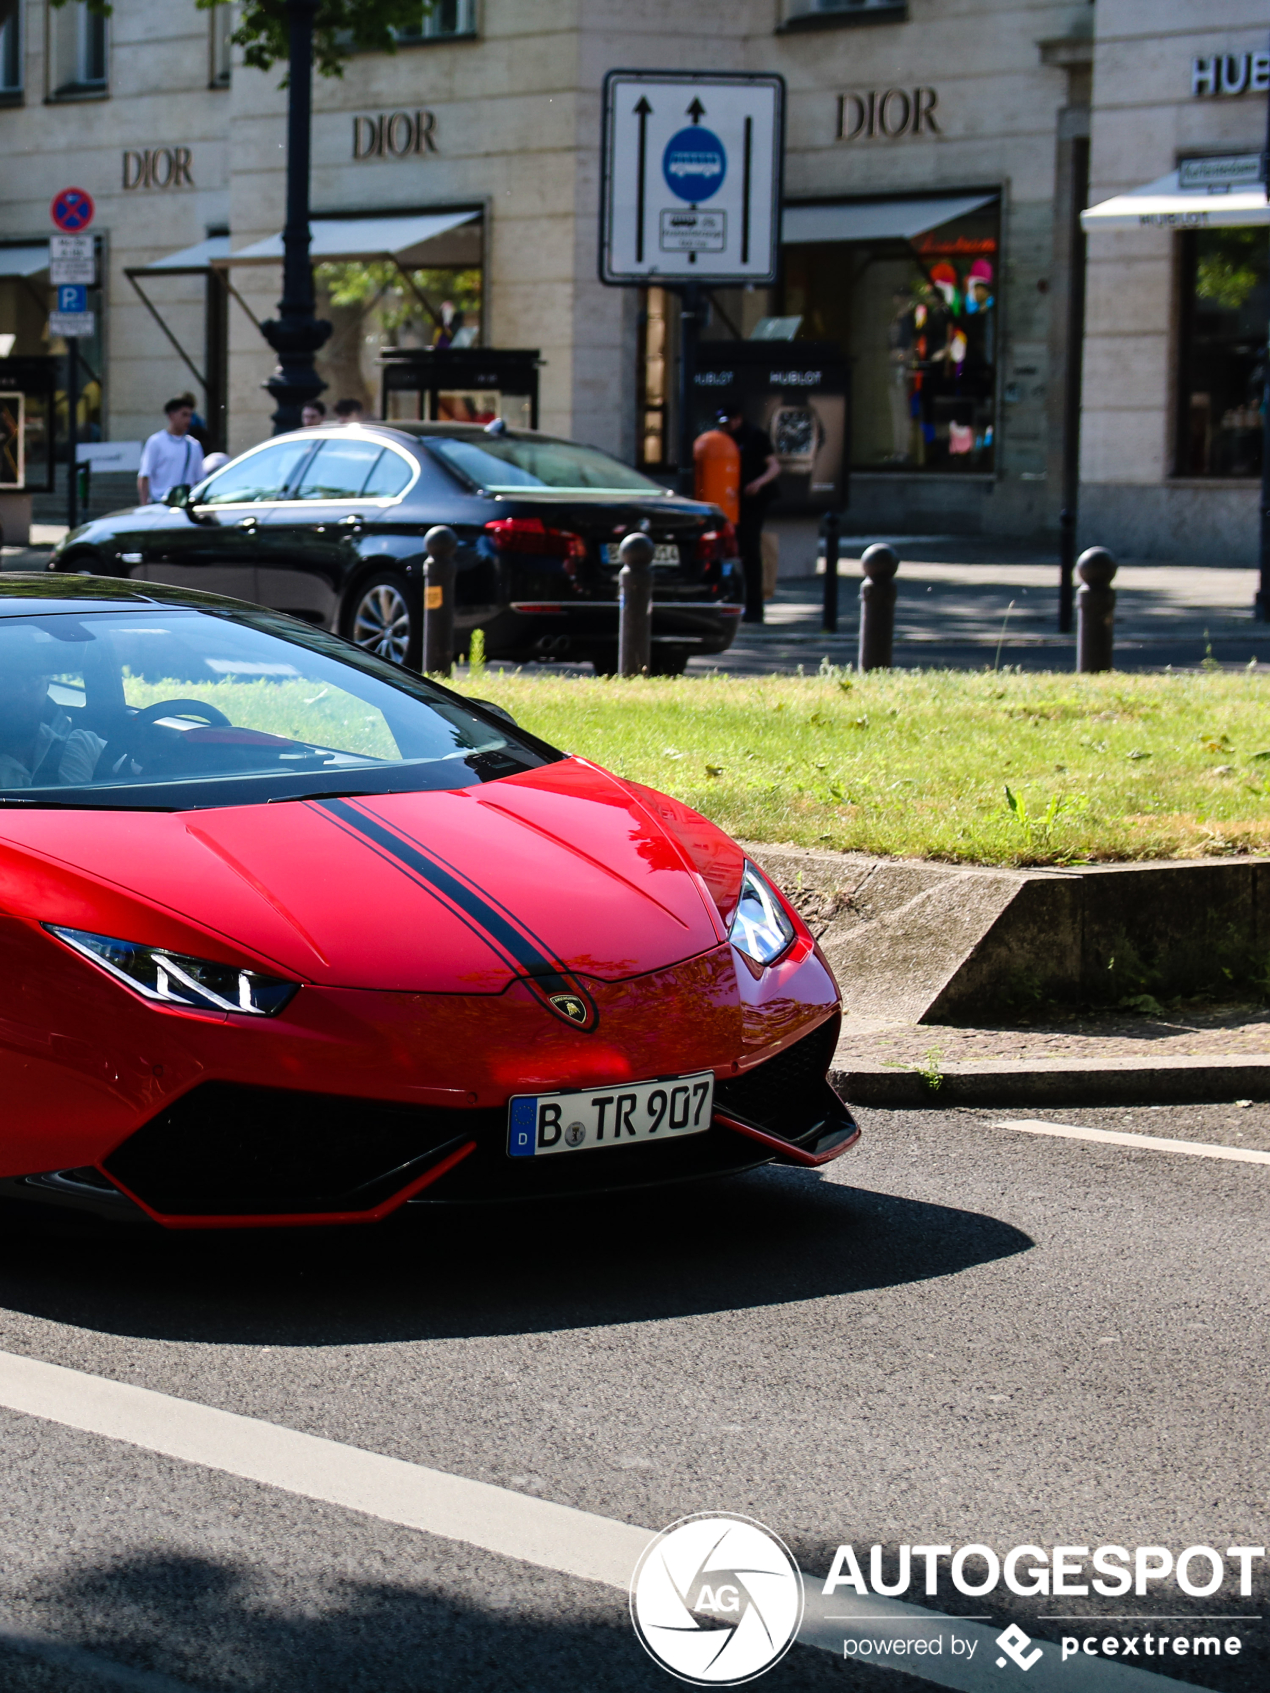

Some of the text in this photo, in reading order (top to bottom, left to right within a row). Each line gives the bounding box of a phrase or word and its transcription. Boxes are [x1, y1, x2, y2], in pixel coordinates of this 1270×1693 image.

[836, 87, 943, 140] DIOR
[354, 110, 439, 160] DIOR
[123, 147, 194, 190] DIOR
[1138, 211, 1209, 229] HUBLOT
[62, 287, 78, 308] P
[769, 370, 822, 386] HUBLOT
[538, 1102, 562, 1148] B
[591, 1093, 637, 1140] TR
[647, 1081, 710, 1133] 907
[518, 1132, 528, 1145] D
